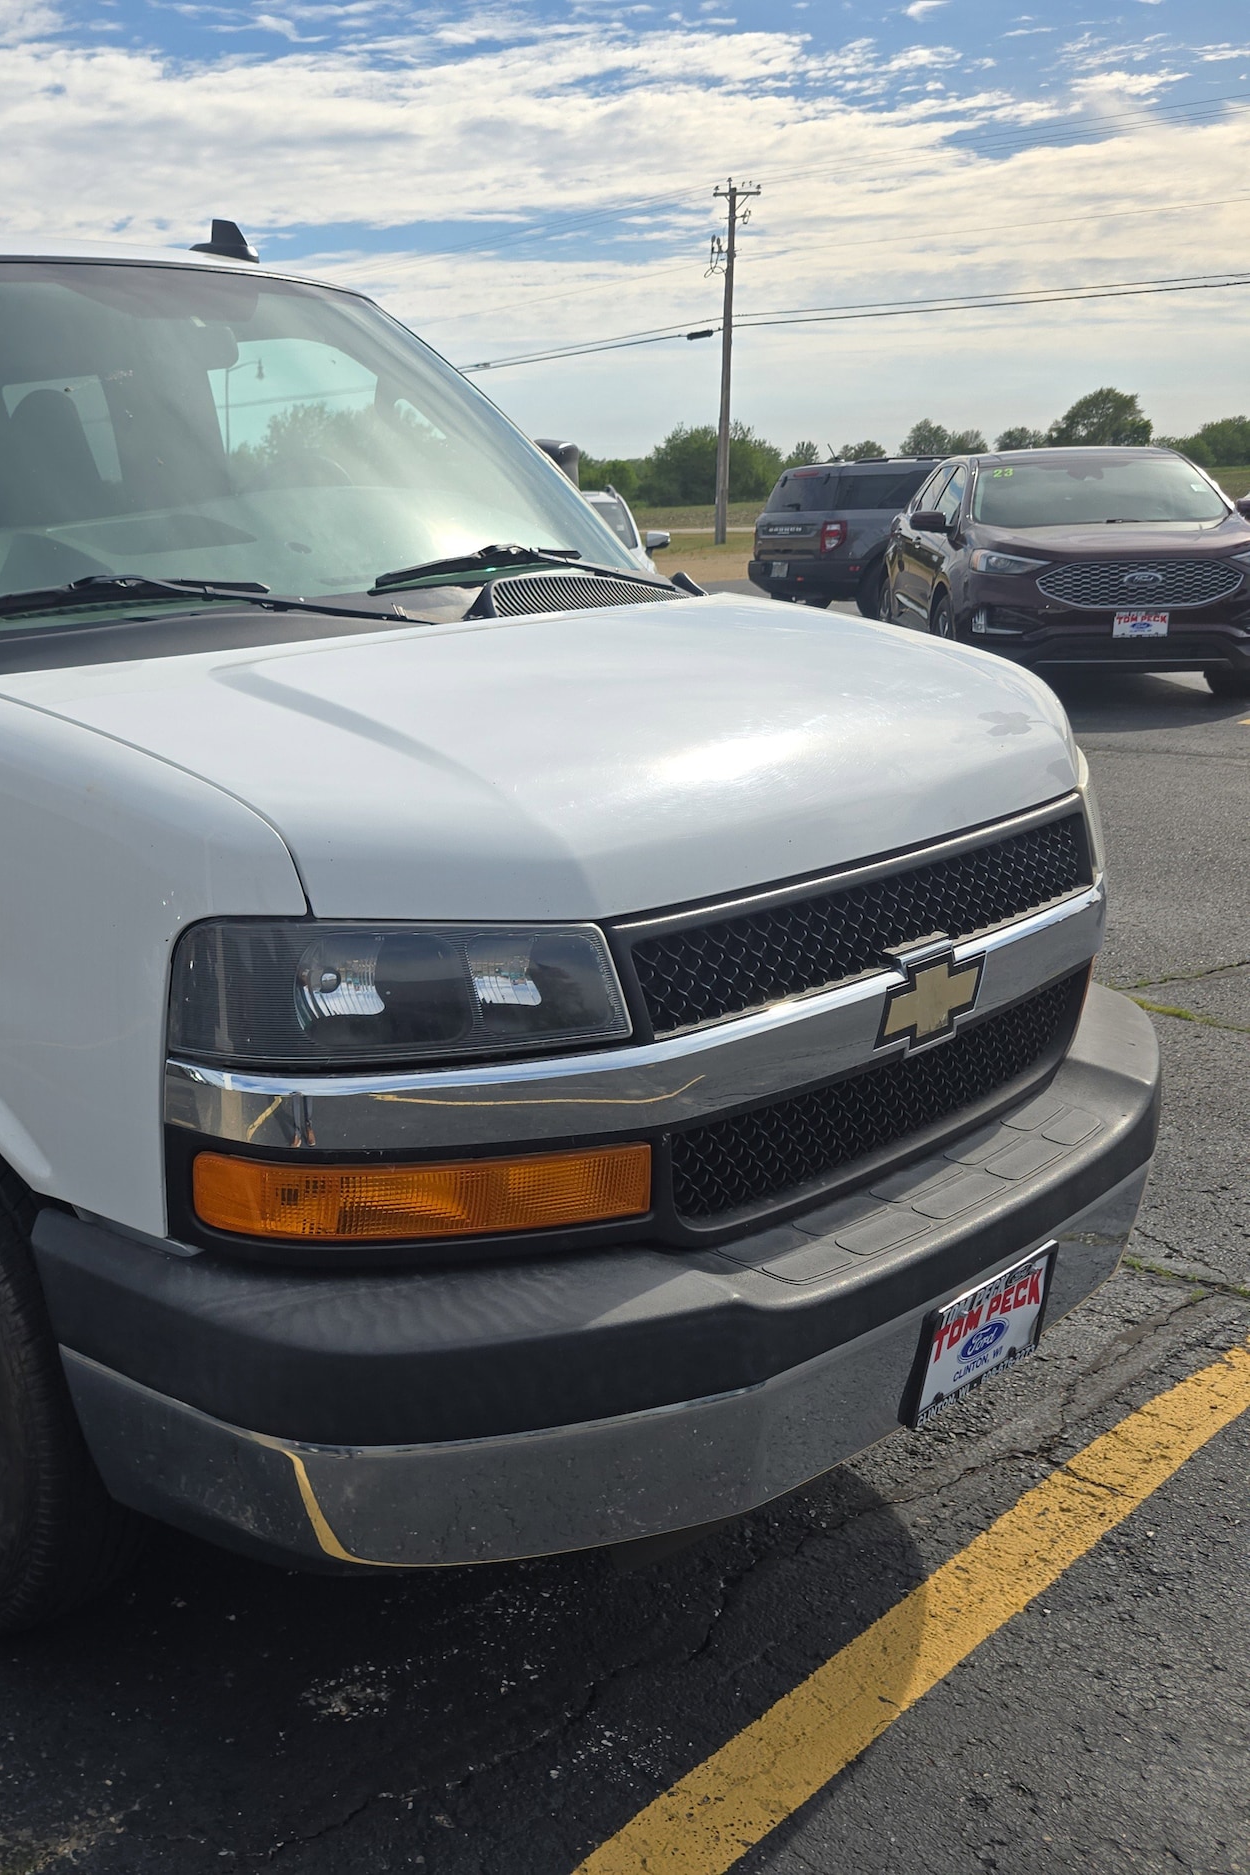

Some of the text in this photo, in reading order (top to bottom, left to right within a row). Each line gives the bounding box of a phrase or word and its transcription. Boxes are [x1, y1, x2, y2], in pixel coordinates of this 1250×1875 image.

[993, 467, 1014, 478] 23
[1116, 614, 1167, 625] TOM PECK
[934, 1304, 984, 1363] TOM
[985, 1268, 1043, 1322] PECK
[967, 1326, 999, 1356] Ford
[953, 1354, 989, 1382] CLINTON,
